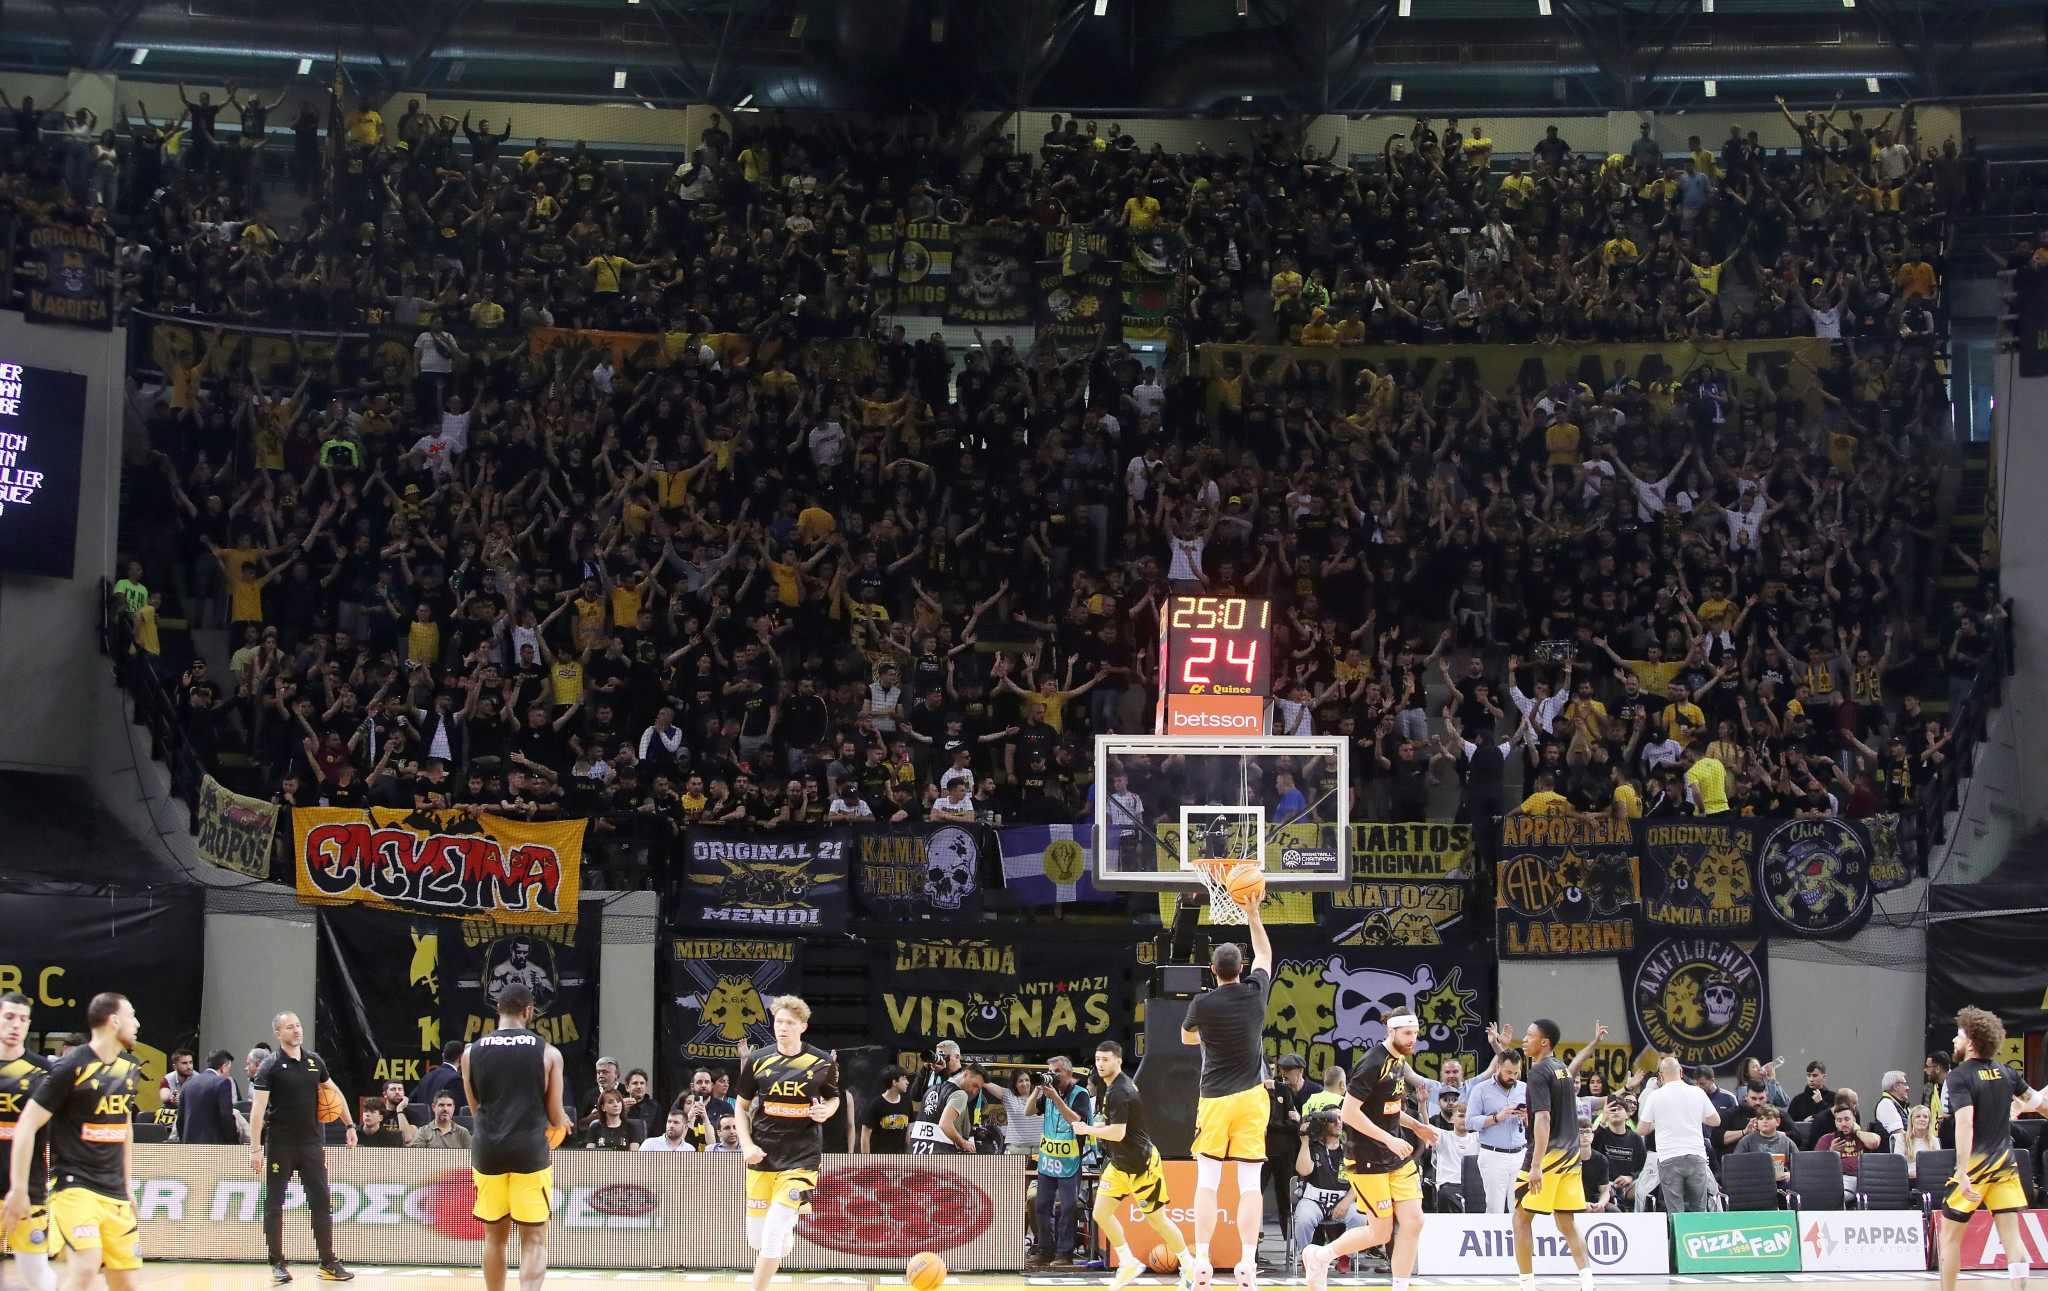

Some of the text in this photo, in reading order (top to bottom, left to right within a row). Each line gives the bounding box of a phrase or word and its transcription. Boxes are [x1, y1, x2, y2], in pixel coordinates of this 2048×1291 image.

[1172, 597, 1269, 629] 25:01
[1183, 637, 1258, 683] 24
[1213, 685, 1251, 694] Quince
[1174, 710, 1257, 727] betsson
[1647, 826, 1753, 853] ORIGINAL 21
[694, 840, 842, 861] ORIGINAL 21
[861, 836, 927, 865] KAMA
[1426, 885, 1462, 911] 21
[702, 907, 820, 926] MENIDI
[1647, 899, 1752, 926] LAMIA CLUB
[1507, 921, 1633, 953] LABRINI
[1068, 975, 1110, 993] NAZI
[1737, 997, 1758, 1032] SIDE
[479, 1034, 537, 1048] macron
[373, 1058, 421, 1080] AEK
[768, 1081, 809, 1097] AEK
[95, 1094, 131, 1115] AEK
[919, 1124, 934, 1137] HB
[912, 1142, 935, 1155] 121
[747, 1199, 767, 1209] AVIS
[1458, 1230, 1574, 1257] Allinz
[1844, 1227, 1919, 1244] PAPPAS
[1733, 1244, 1751, 1254] 1996
[1844, 1245, 1921, 1254] ELEVATORS
